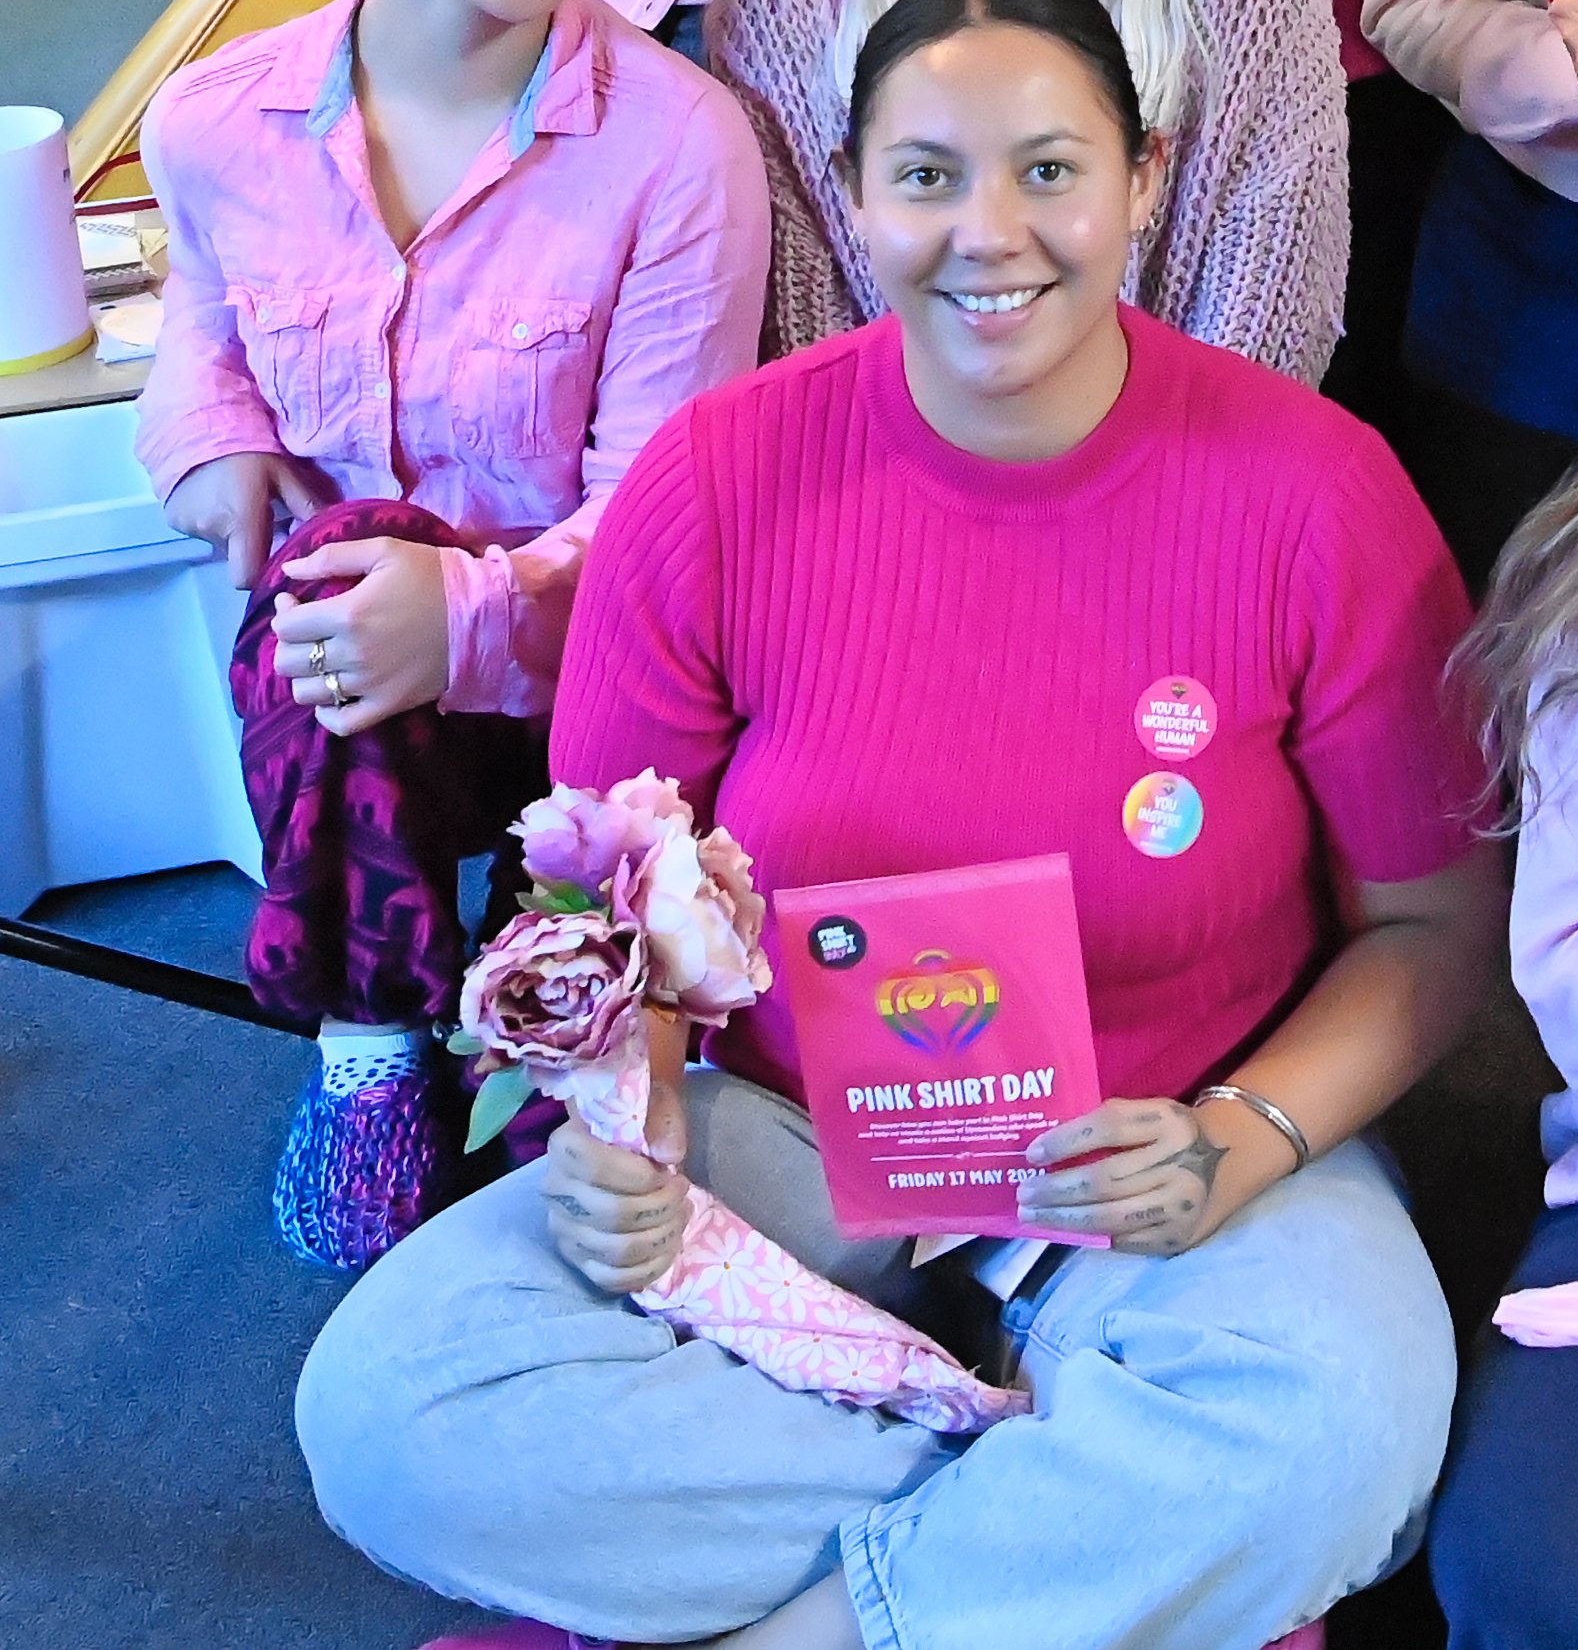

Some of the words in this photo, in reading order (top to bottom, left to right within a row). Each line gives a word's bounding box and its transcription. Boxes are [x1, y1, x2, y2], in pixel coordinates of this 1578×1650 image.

[1150, 701, 1189, 716] YOU'RE
[1192, 704, 1202, 719] A
[1142, 714, 1210, 733] WONDERFUL
[1154, 731, 1197, 746] HUMAN
[1154, 795, 1178, 811] YOU
[846, 1082, 914, 1113] PINK
[917, 1075, 997, 1109] SHIRT
[1002, 1067, 1056, 1100] DAY
[888, 1171, 945, 1189] FRIDAY
[948, 1170, 966, 1186] 17
[969, 1169, 1003, 1185] MAY
